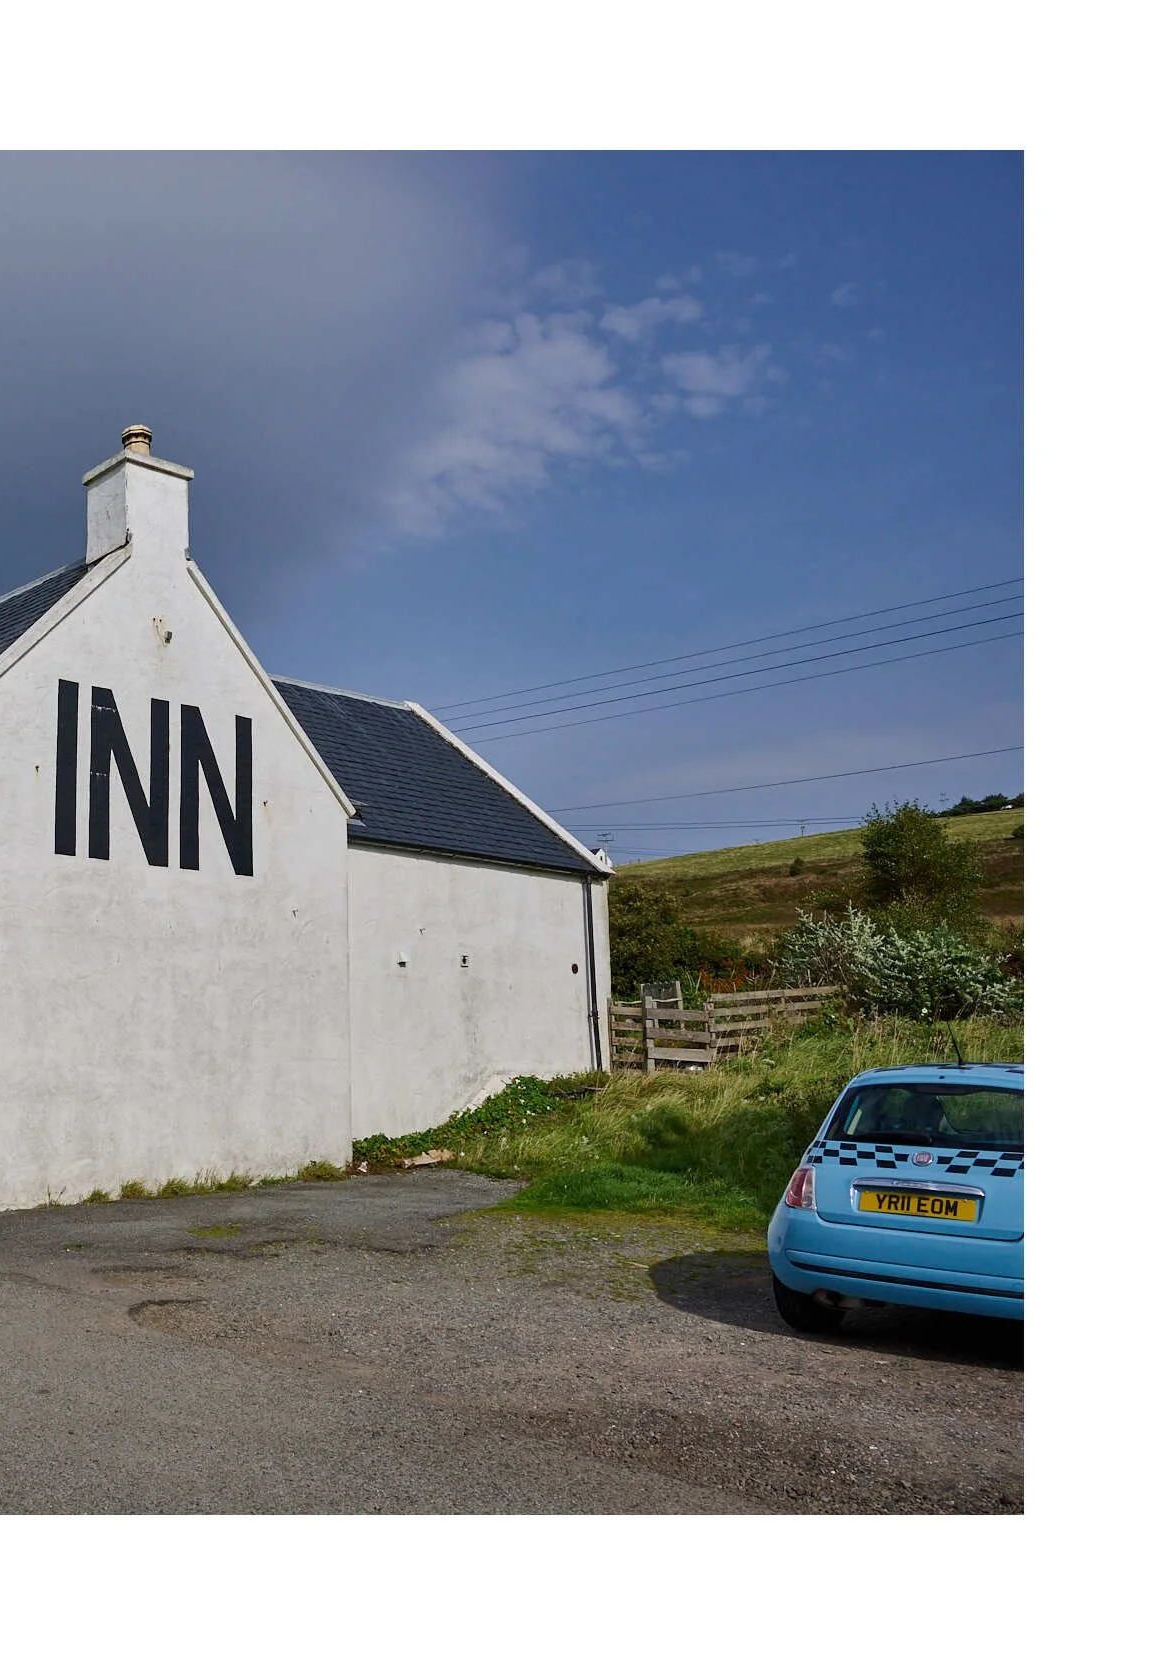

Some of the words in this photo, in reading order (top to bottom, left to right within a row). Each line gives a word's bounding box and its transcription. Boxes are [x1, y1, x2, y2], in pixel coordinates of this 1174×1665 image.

[54, 679, 254, 877] INN
[876, 1194, 911, 1212] YR11
[917, 1198, 958, 1217] EOM
